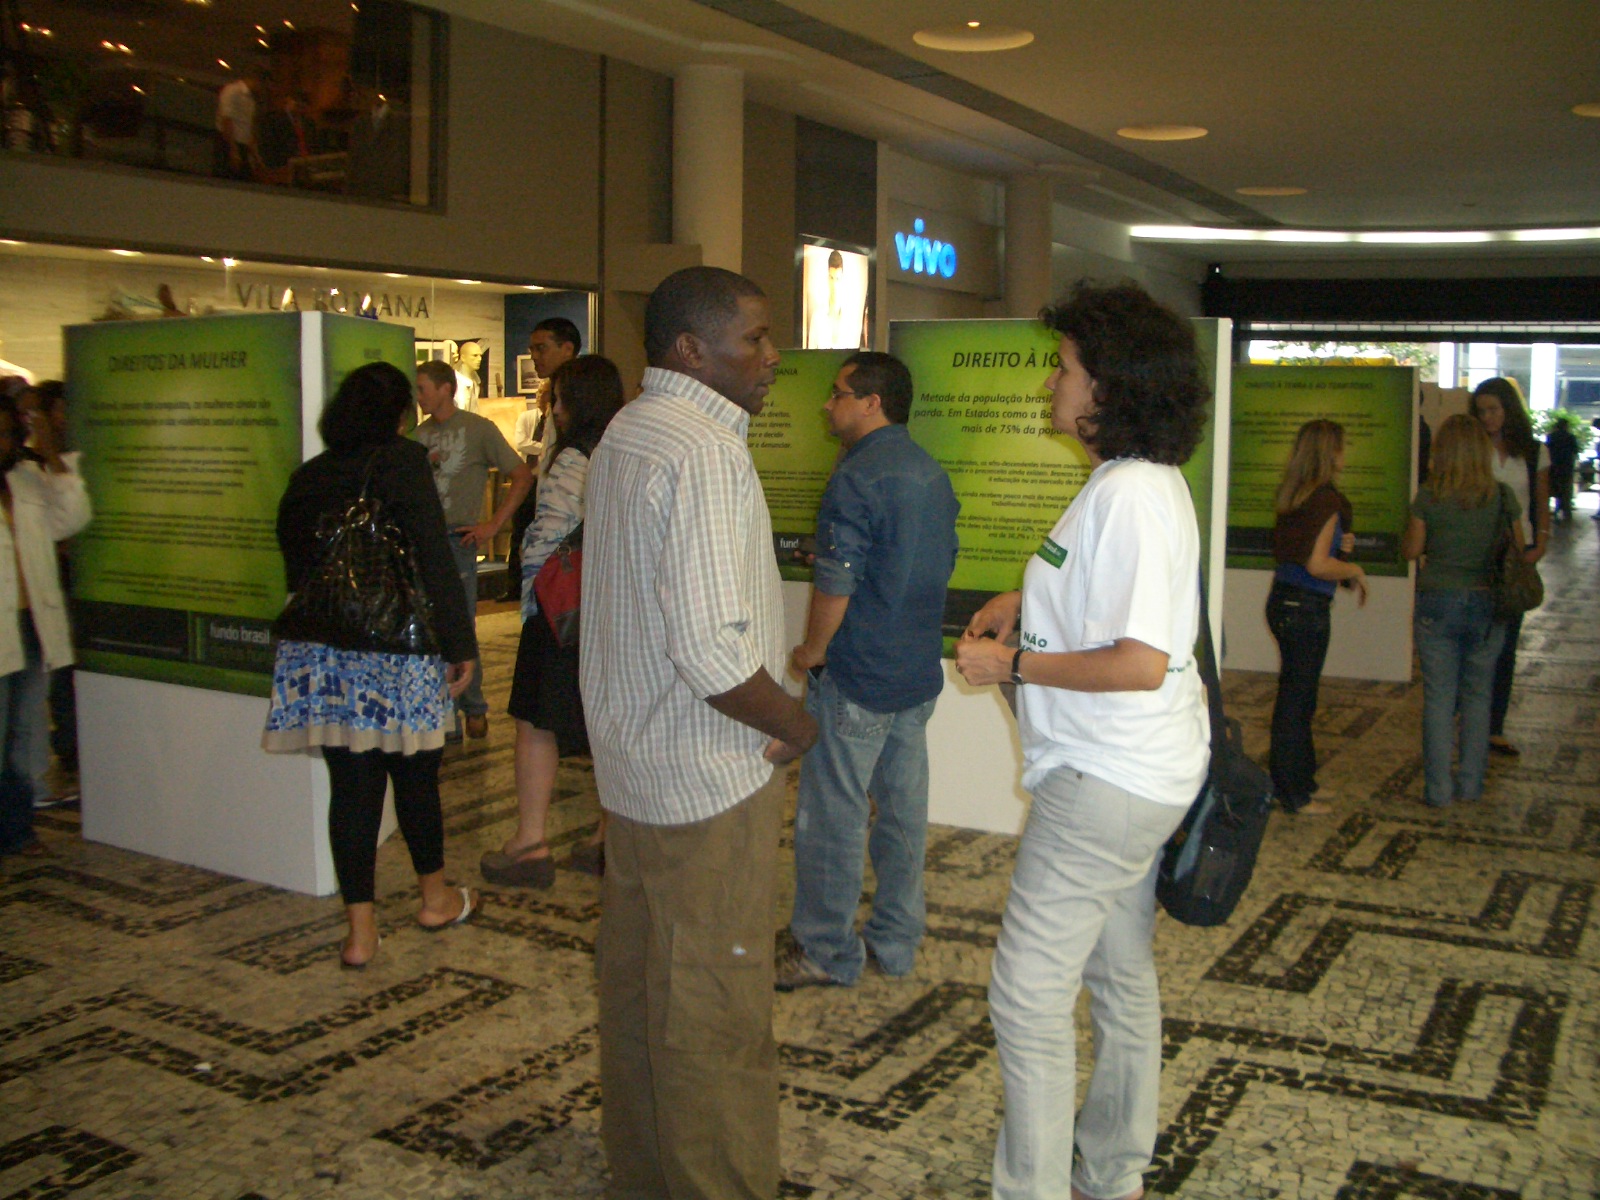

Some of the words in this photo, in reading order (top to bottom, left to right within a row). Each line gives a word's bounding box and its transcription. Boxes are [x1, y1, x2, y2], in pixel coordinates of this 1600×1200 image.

[895, 218, 957, 278] vivo
[236, 282, 301, 311] VILA
[108, 354, 166, 373] DIREITOS
[168, 353, 187, 371] DA
[190, 351, 248, 370] MULHER
[952, 352, 1021, 368] DIREITO
[1025, 347, 1037, 368] À
[920, 393, 956, 403] Metade
[958, 393, 970, 403] da
[972, 393, 1023, 405] população
[914, 408, 945, 419] parda.
[948, 409, 962, 417] Em
[965, 409, 1000, 418] Estados
[1002, 411, 1028, 419] como
[961, 424, 982, 433] mais
[985, 424, 997, 433] de
[999, 424, 1021, 434] 75%
[1023, 425, 1036, 434] da
[240, 624, 270, 645] brasil
[1024, 631, 1048, 648] NÃO
